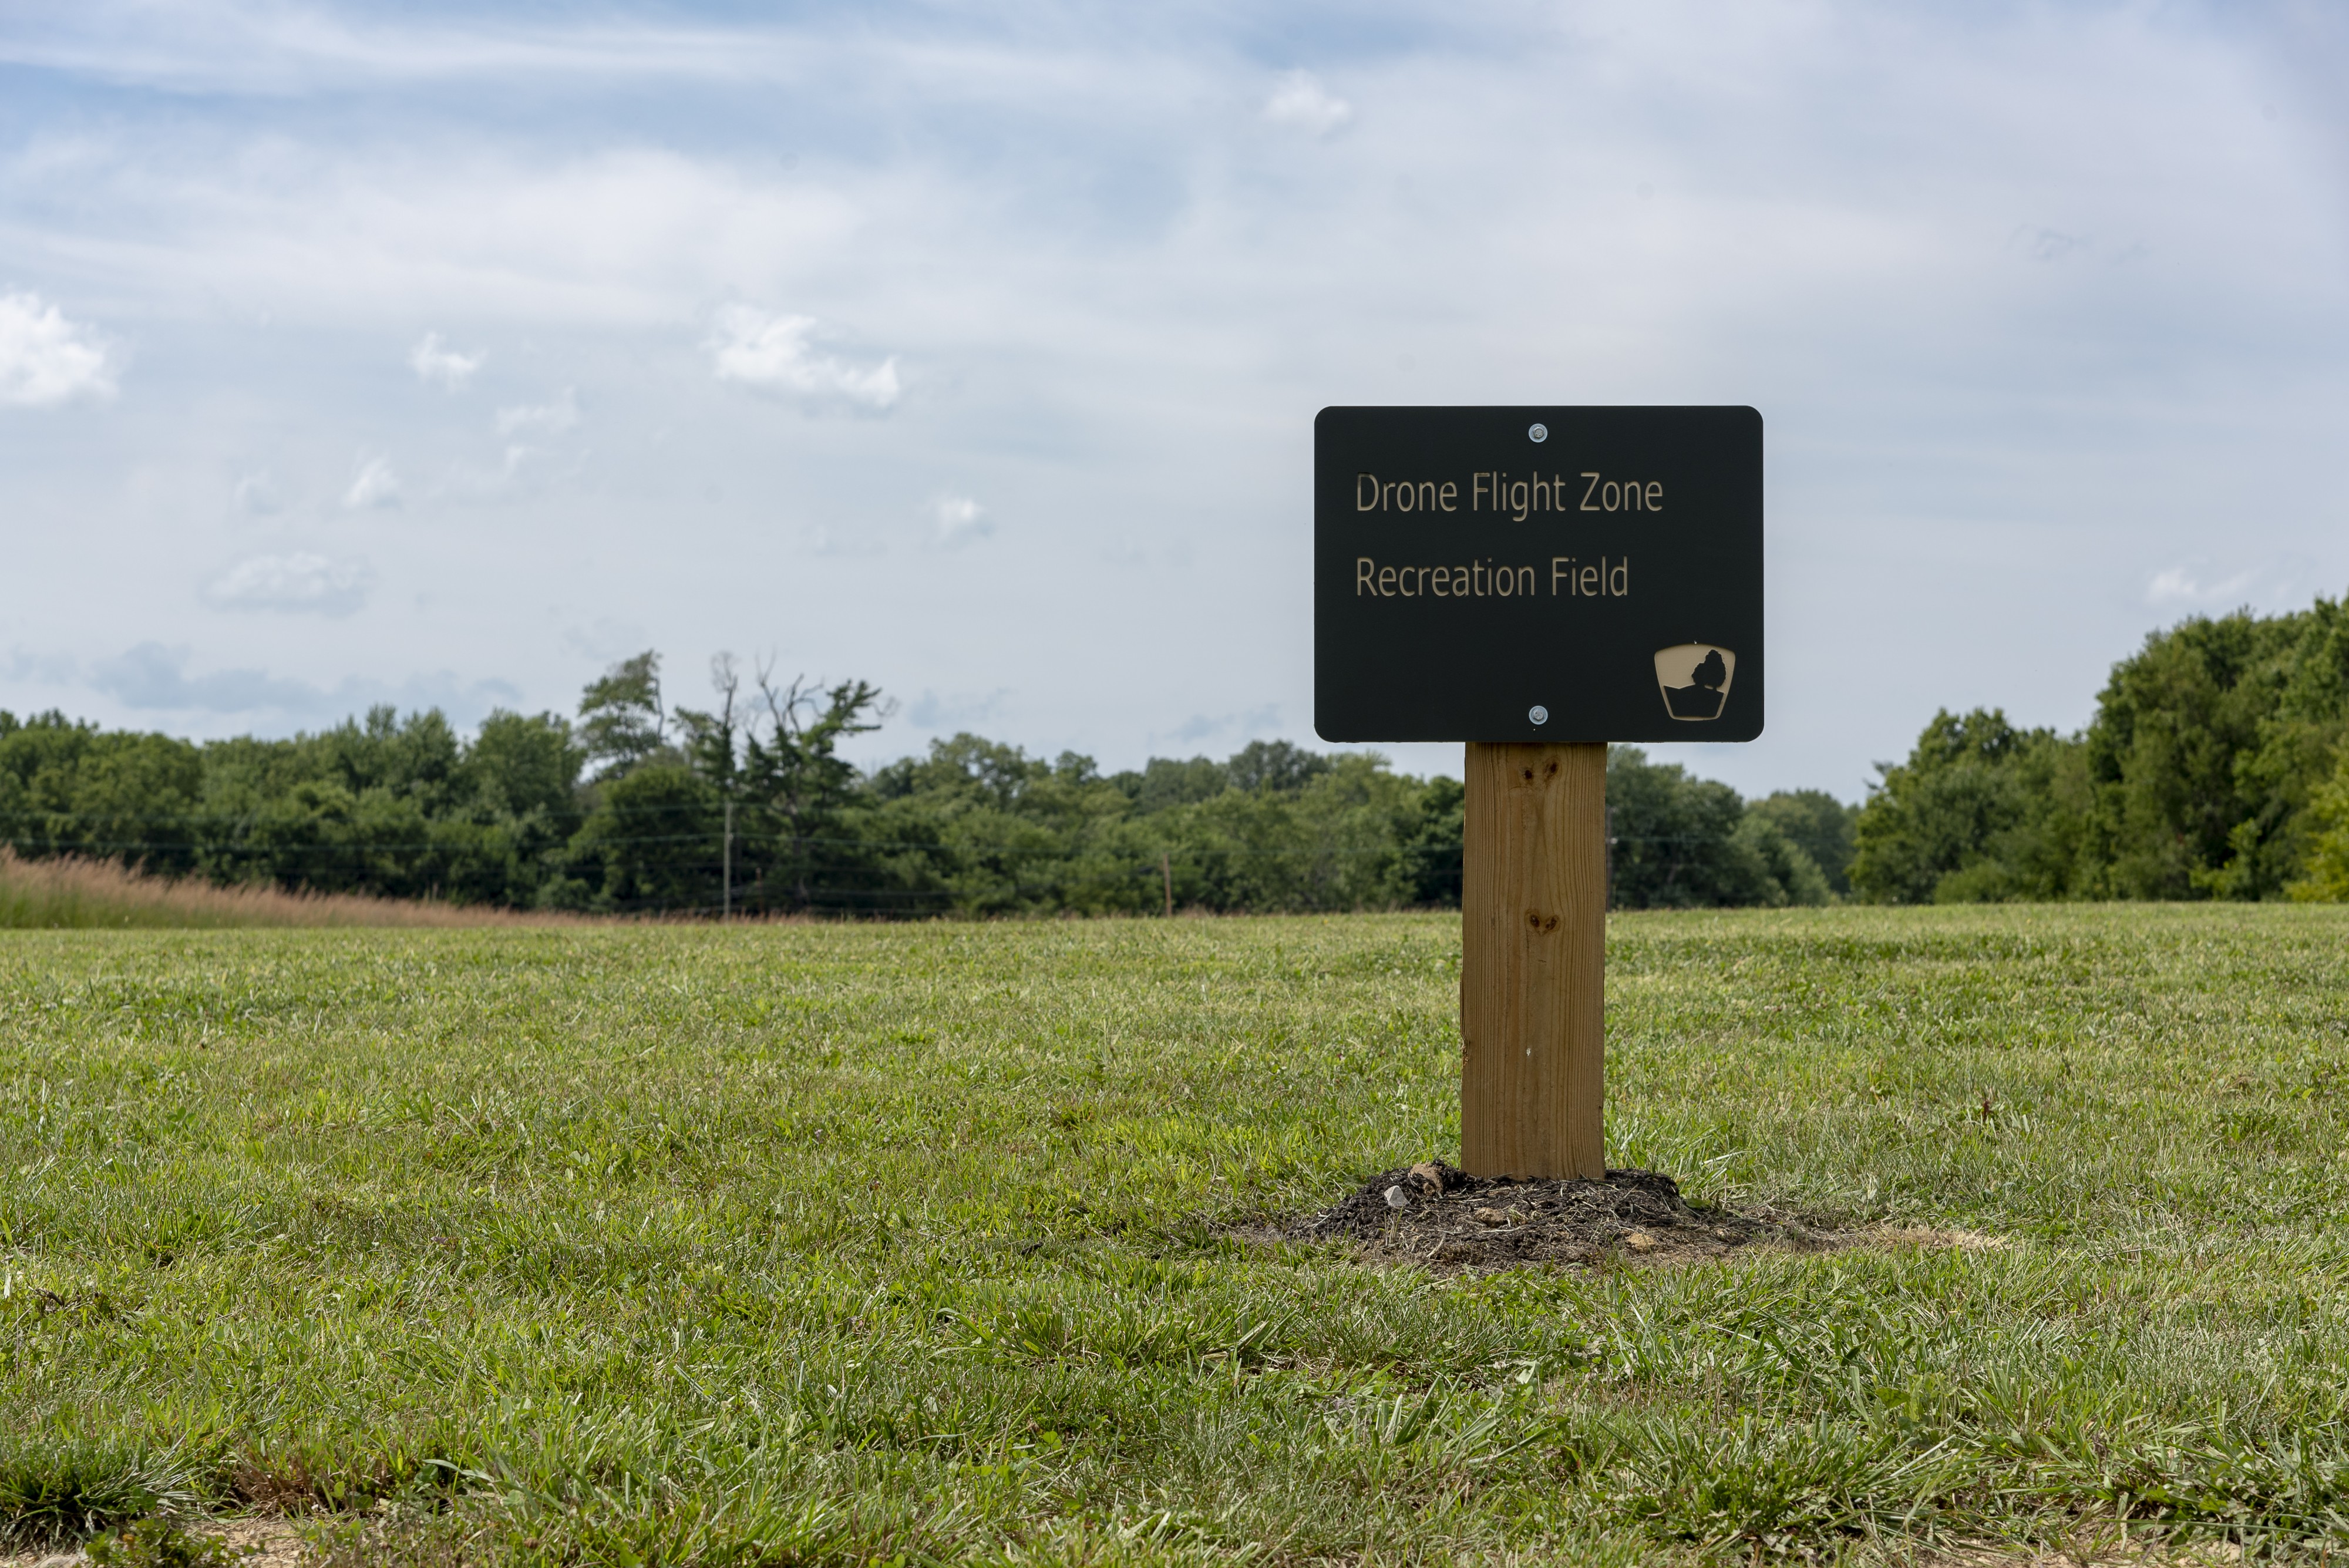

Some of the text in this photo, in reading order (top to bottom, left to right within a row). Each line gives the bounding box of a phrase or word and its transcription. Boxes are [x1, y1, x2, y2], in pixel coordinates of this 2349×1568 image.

[1357, 471, 1663, 521] Drone Flight Zone
[1357, 556, 1628, 597] Recreation Field
